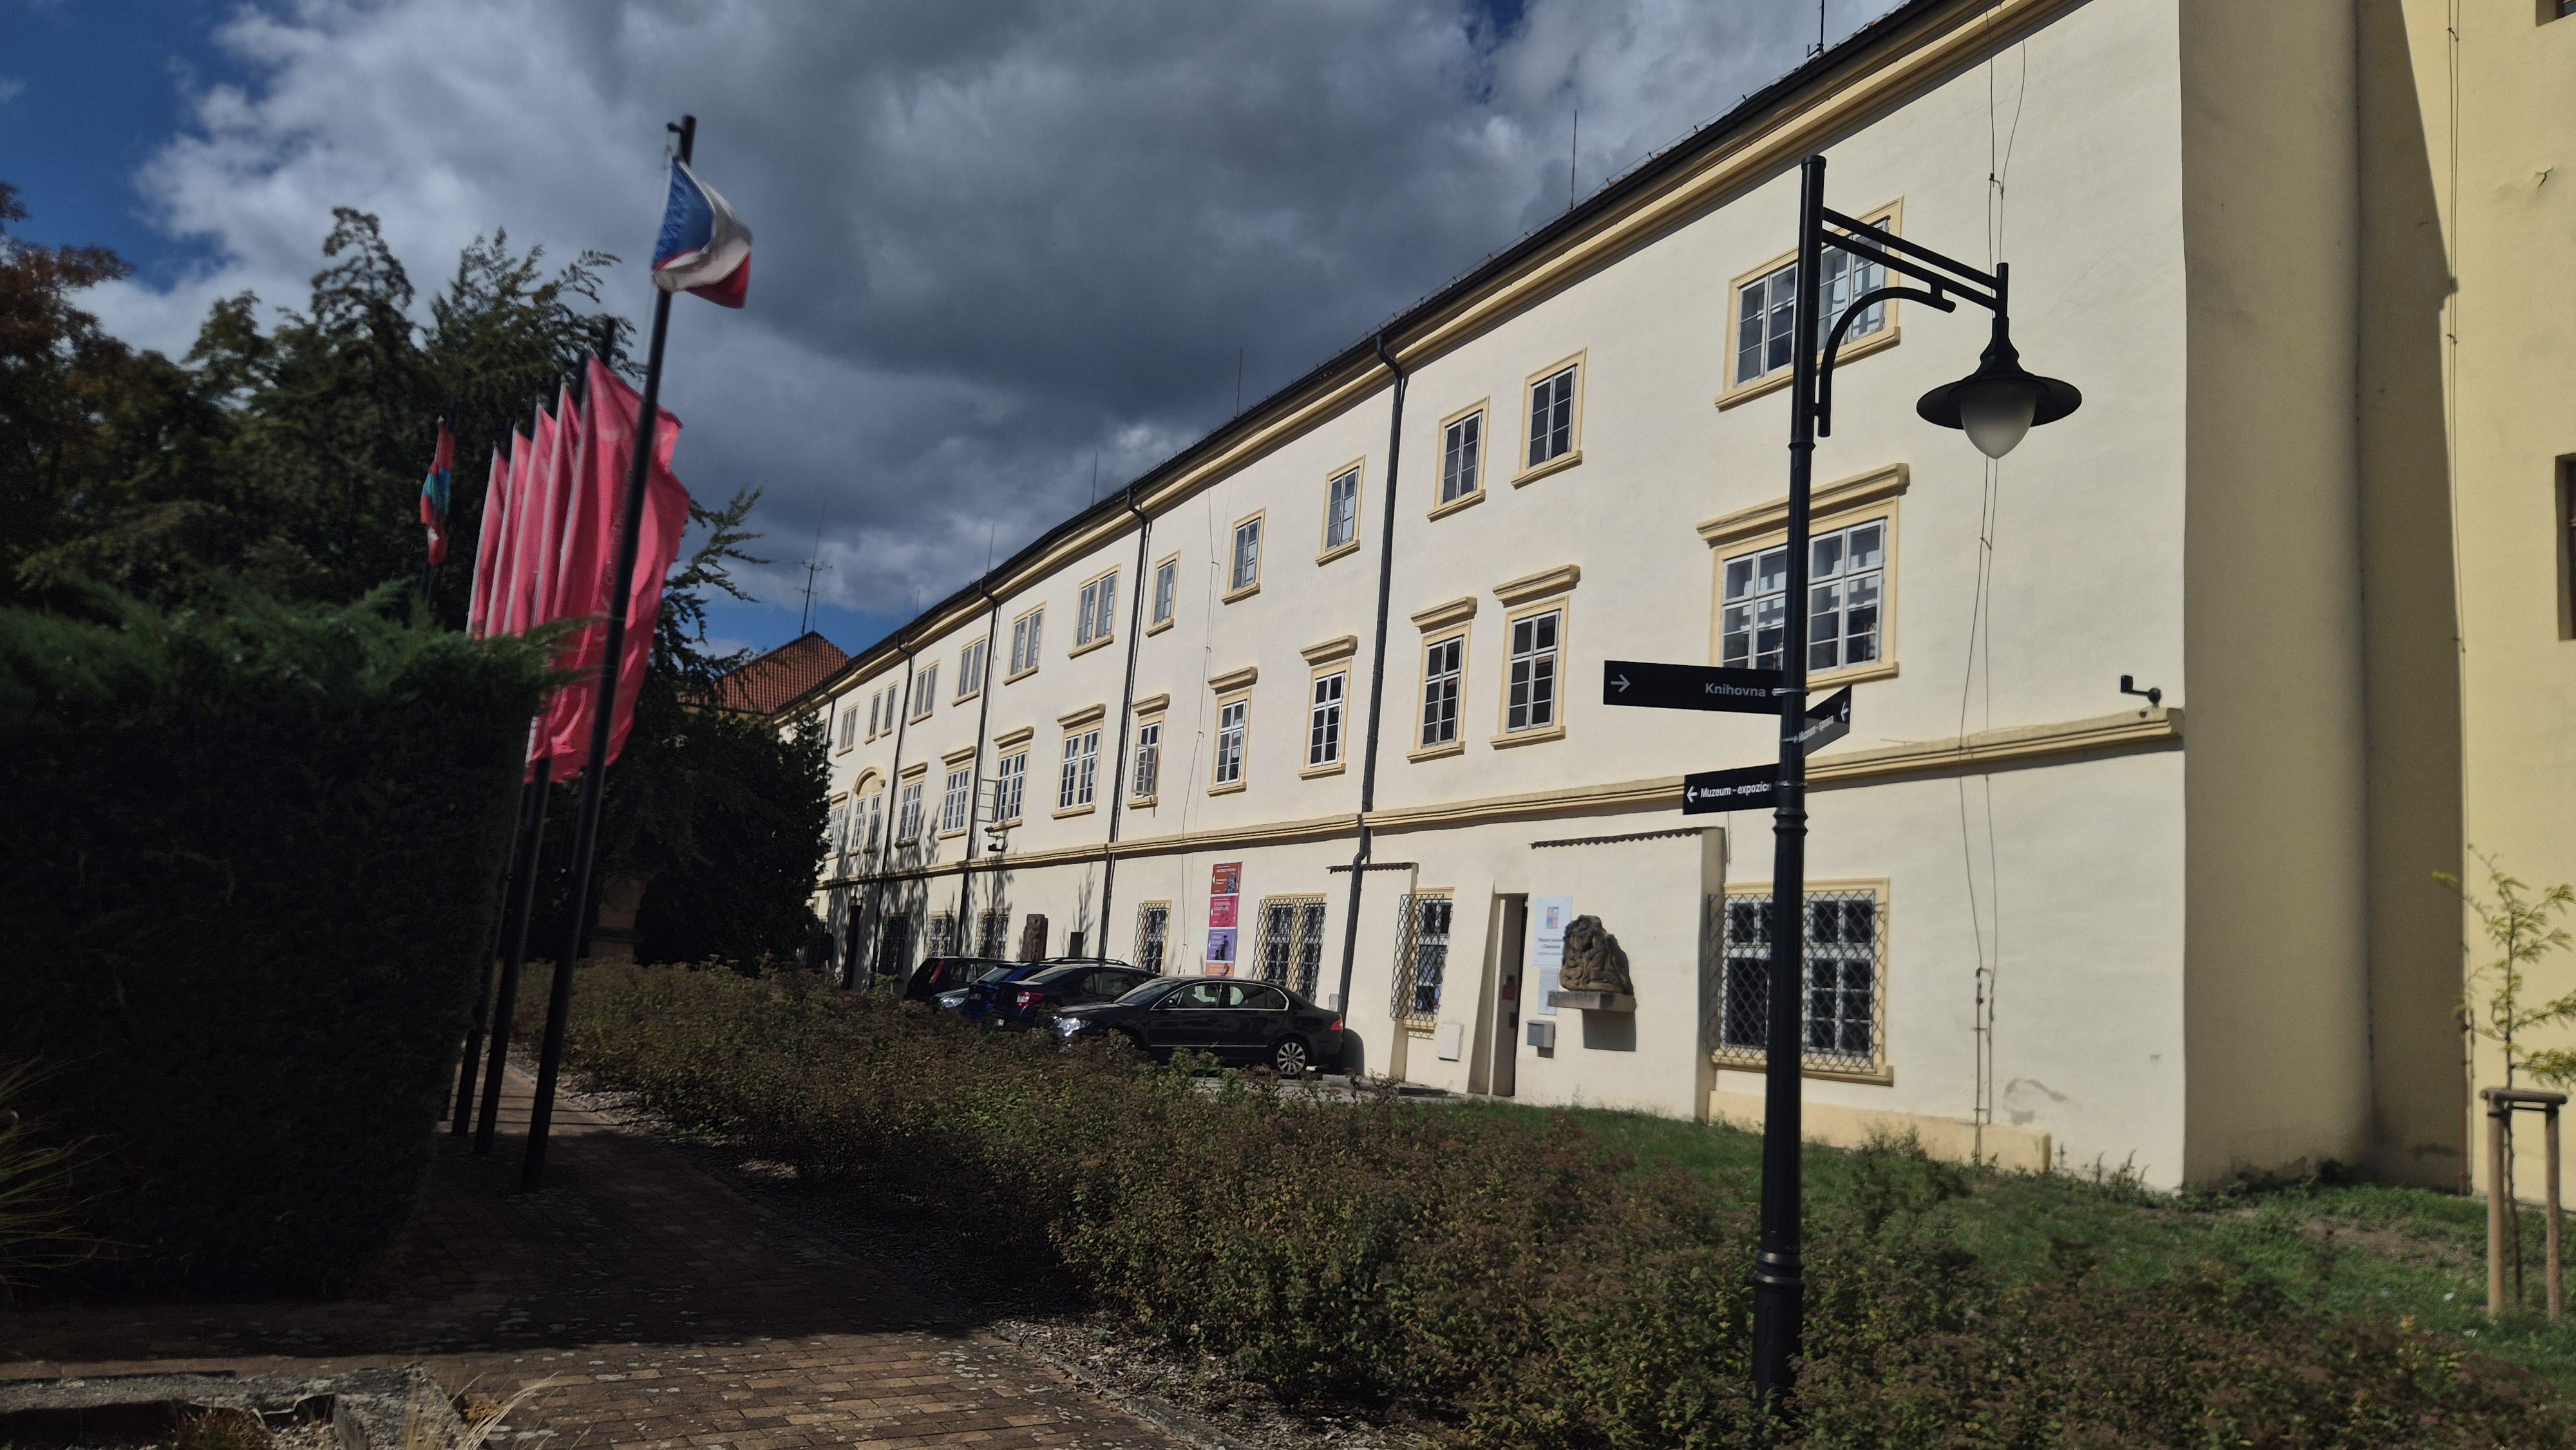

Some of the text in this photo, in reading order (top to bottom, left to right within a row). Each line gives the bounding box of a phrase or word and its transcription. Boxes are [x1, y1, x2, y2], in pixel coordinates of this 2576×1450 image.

[1705, 683, 1766, 697] Knihovna
[1700, 787, 1732, 798] Muzeum
[1737, 780, 1772, 796] expozice
